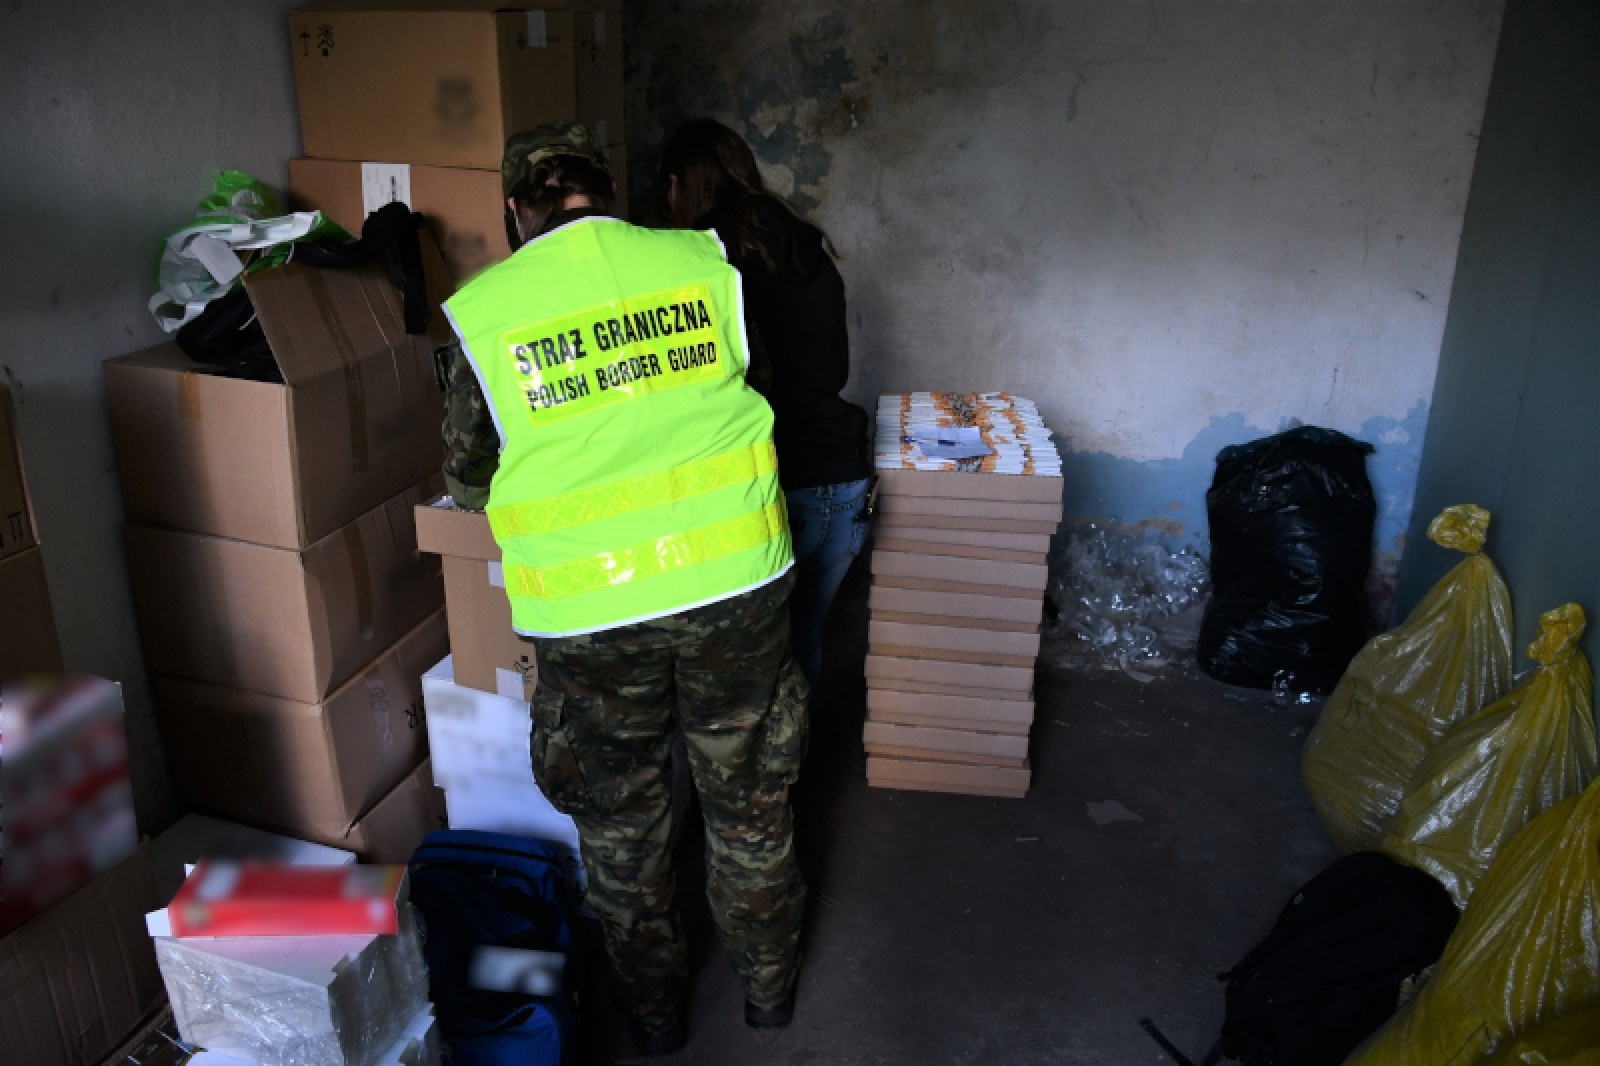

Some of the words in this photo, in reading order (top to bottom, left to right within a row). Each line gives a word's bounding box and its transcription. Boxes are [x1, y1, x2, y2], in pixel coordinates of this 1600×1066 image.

[593, 299, 713, 352] GRANICZNA
[526, 373, 591, 412] POLISH
[595, 353, 663, 391] BORDER
[667, 341, 717, 372] GUARD
